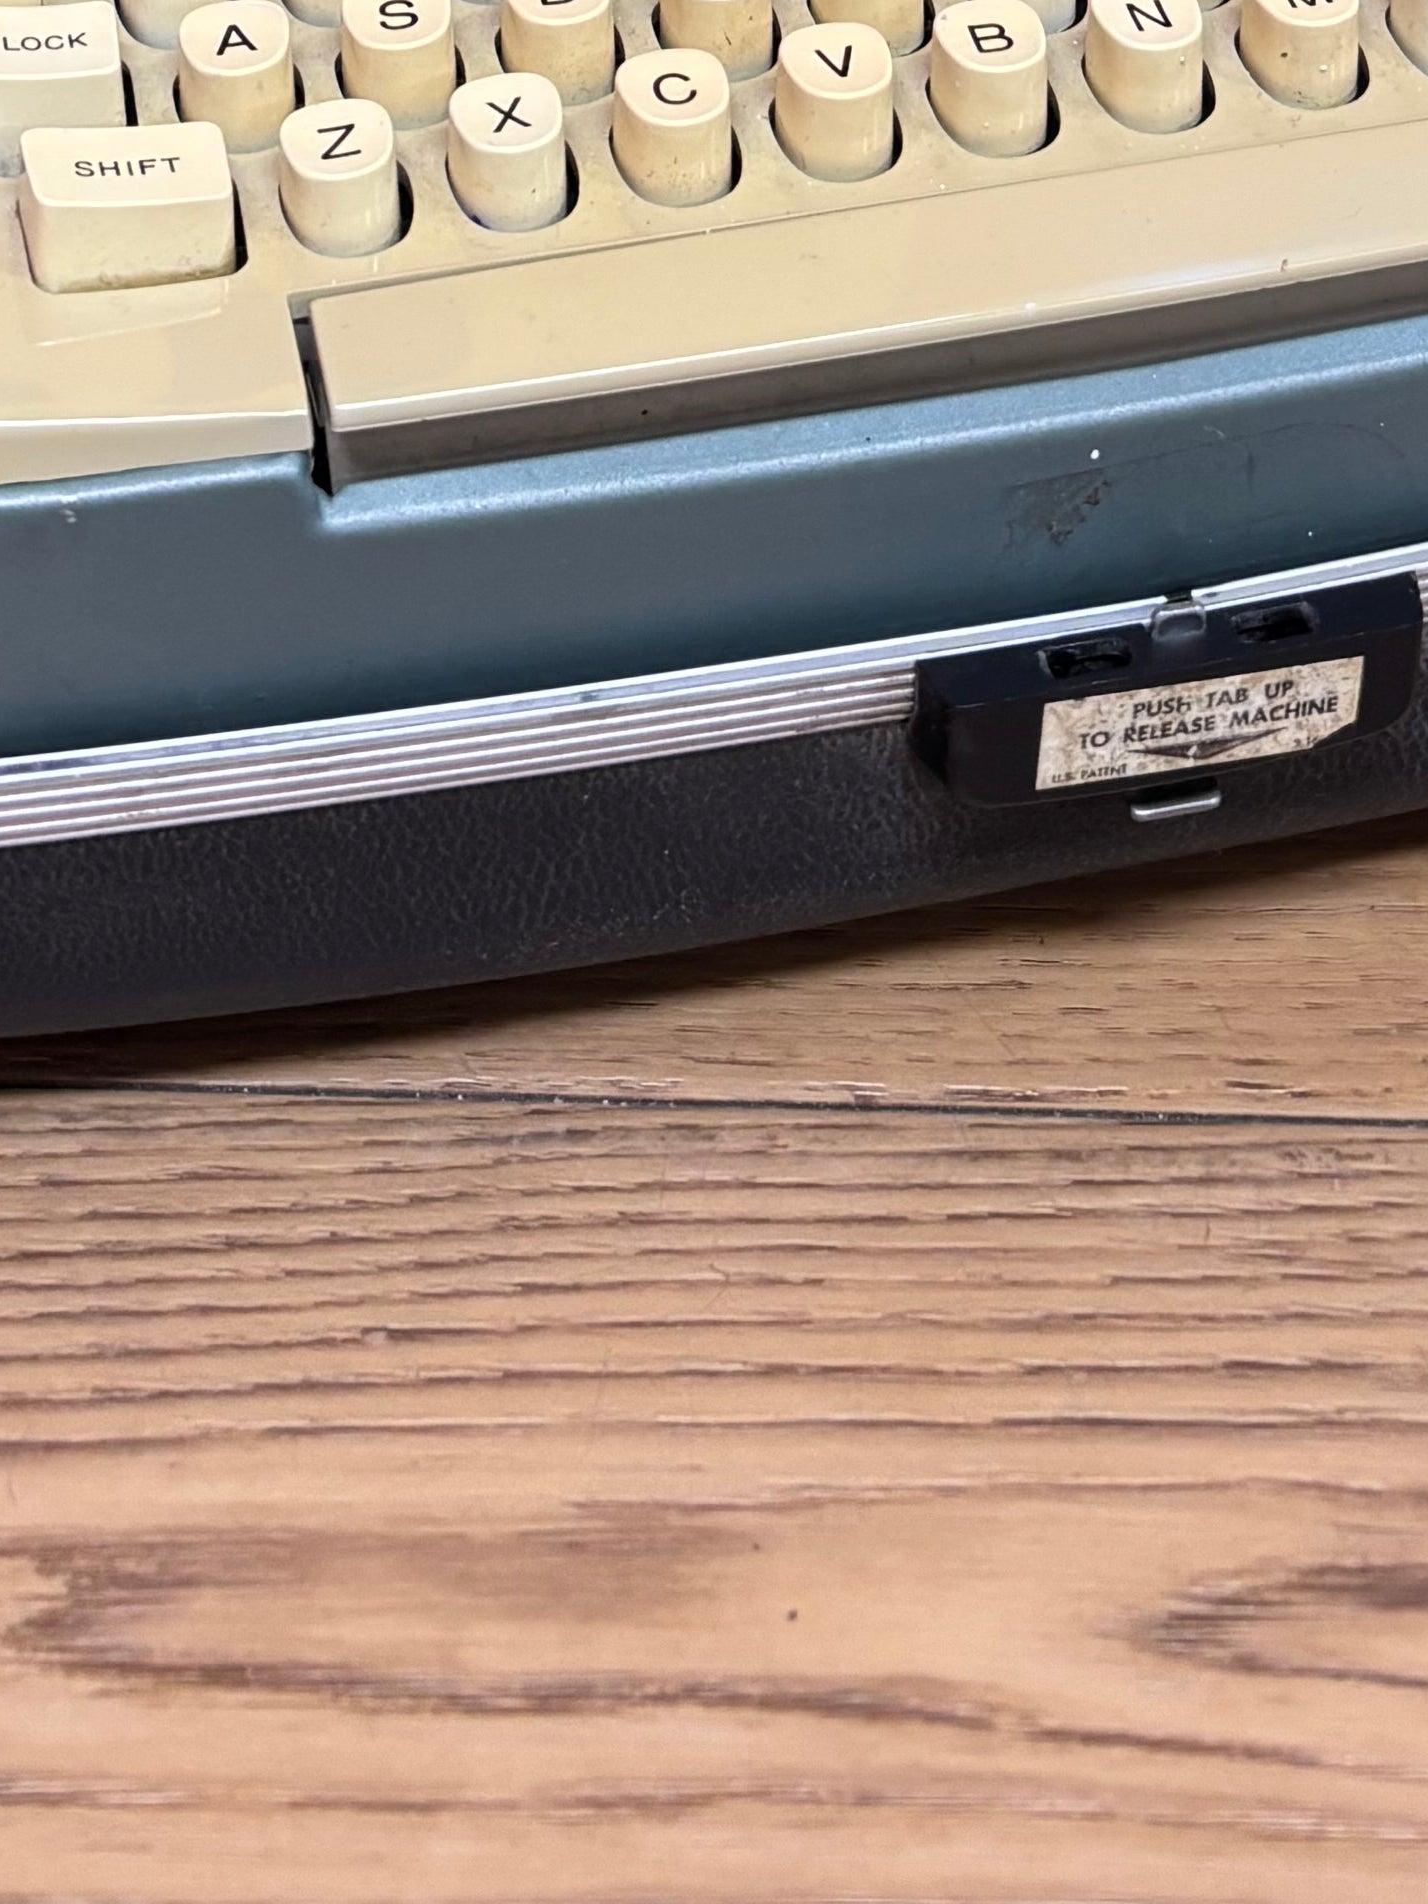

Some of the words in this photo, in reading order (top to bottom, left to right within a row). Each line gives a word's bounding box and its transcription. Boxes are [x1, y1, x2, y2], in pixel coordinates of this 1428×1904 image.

[378, 0, 419, 31] S
[2, 32, 88, 52] LOCK
[216, 24, 258, 57] A
[967, 23, 1014, 54] B
[814, 44, 853, 78] V
[652, 72, 698, 105] C
[486, 96, 532, 134] X
[316, 123, 362, 161] Z
[74, 156, 181, 178] SHIFT
[1132, 697, 1192, 718] PUSH
[1206, 688, 1248, 708] TAB
[1265, 680, 1293, 698] UP
[1079, 731, 1109, 749] TO
[1123, 715, 1215, 743] RELEASE
[1229, 696, 1339, 727] MACHINE
[1080, 764, 1127, 779] PATENT
